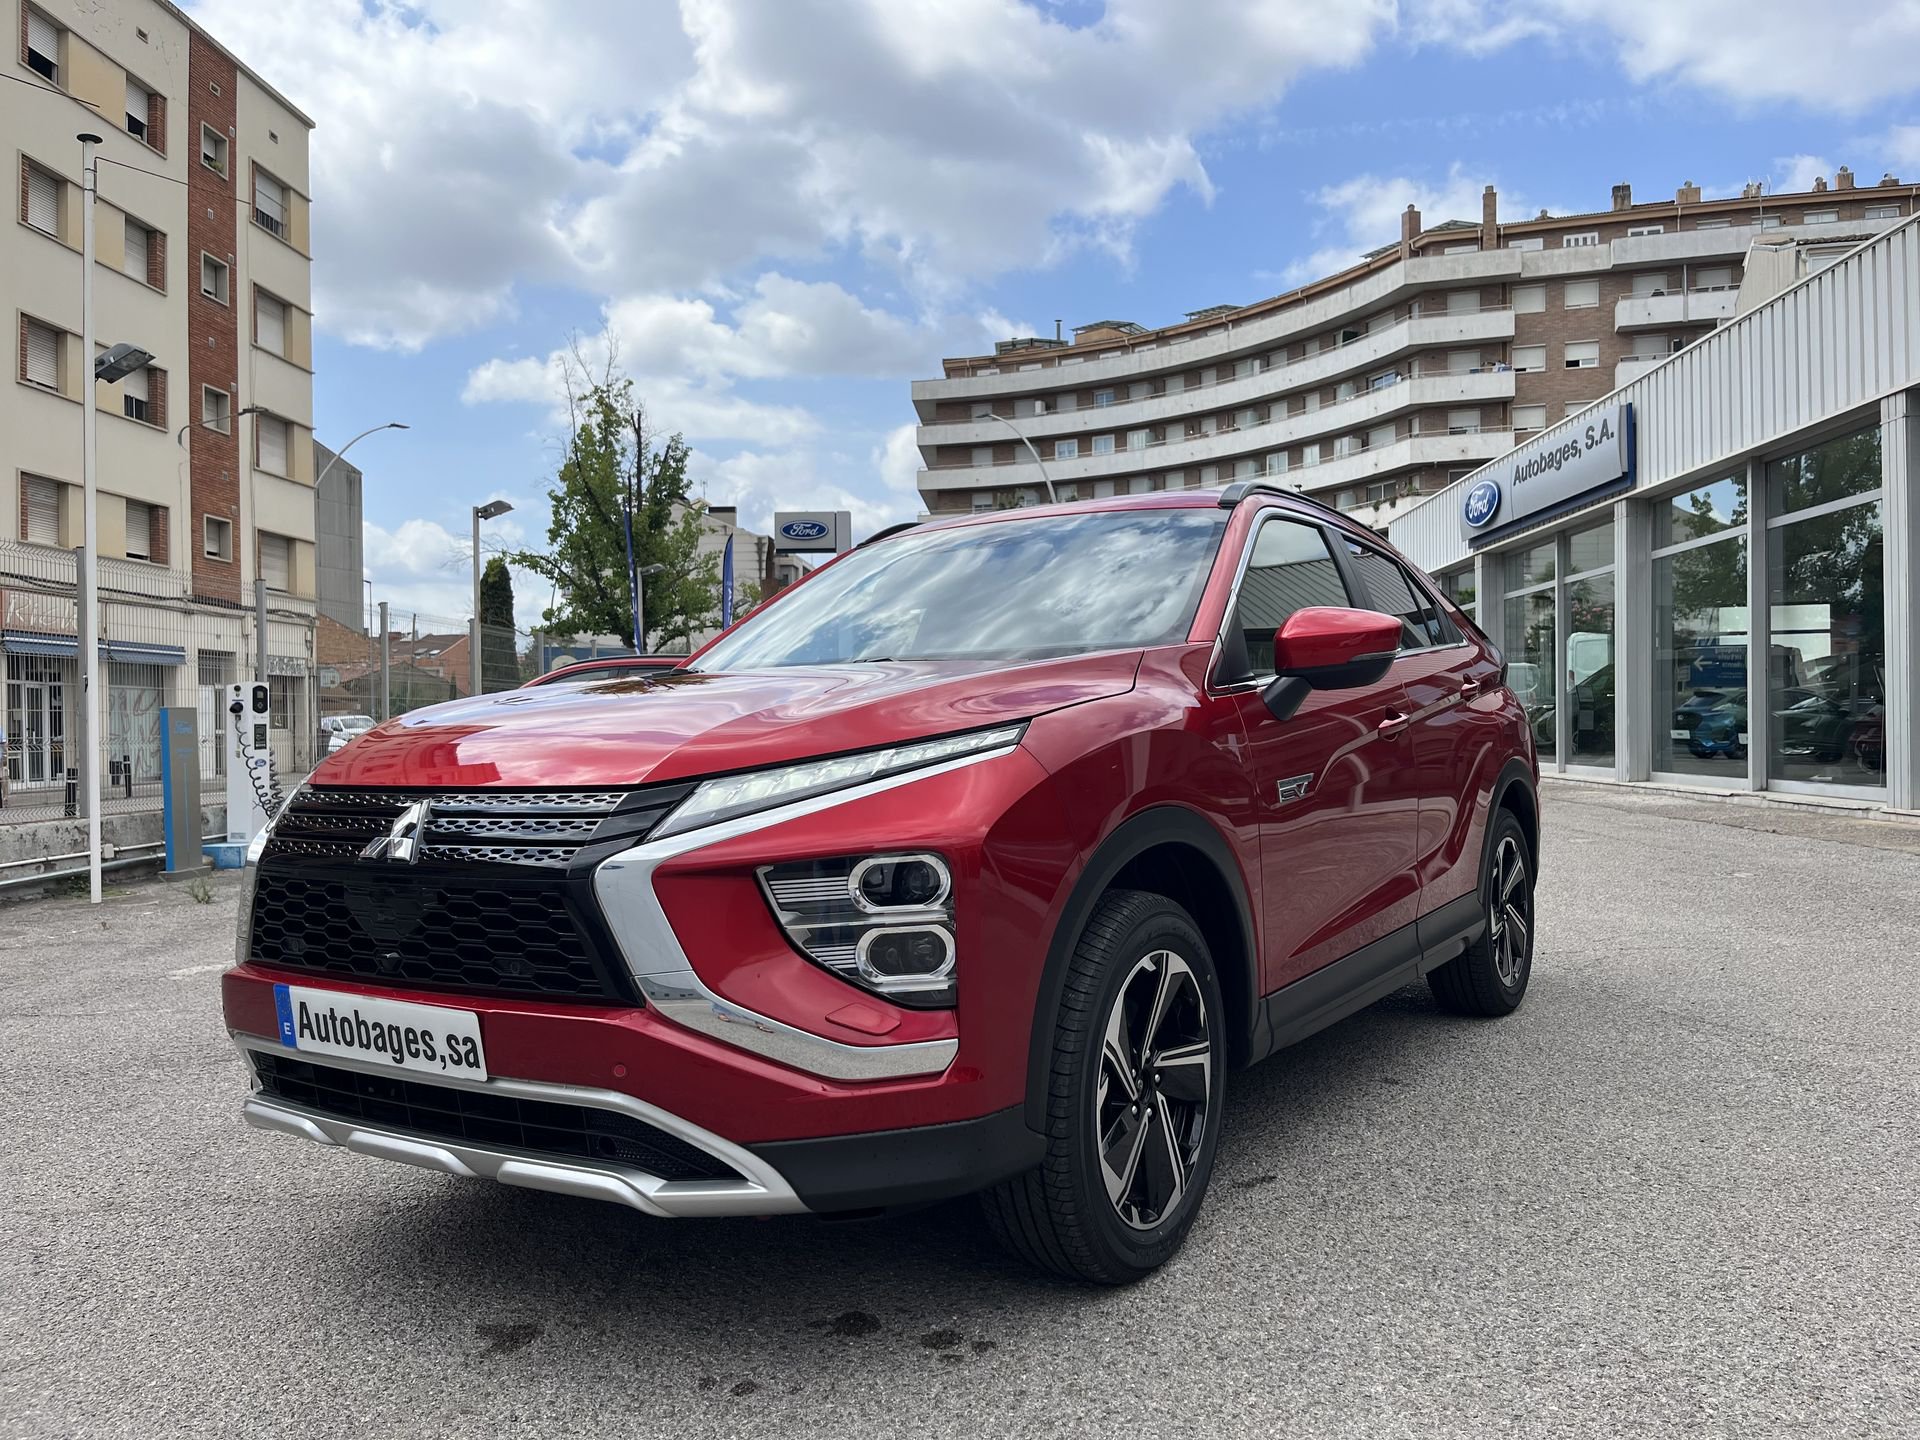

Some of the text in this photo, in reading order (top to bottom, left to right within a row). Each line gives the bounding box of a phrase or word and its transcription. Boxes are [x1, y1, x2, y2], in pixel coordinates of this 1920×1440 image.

[1513, 418, 1615, 486] Autobages, S.A.
[1468, 488, 1490, 519] Ford
[790, 523, 819, 536] Ford
[283, 1022, 292, 1036] E
[299, 1001, 481, 1070] Autobages,sa
